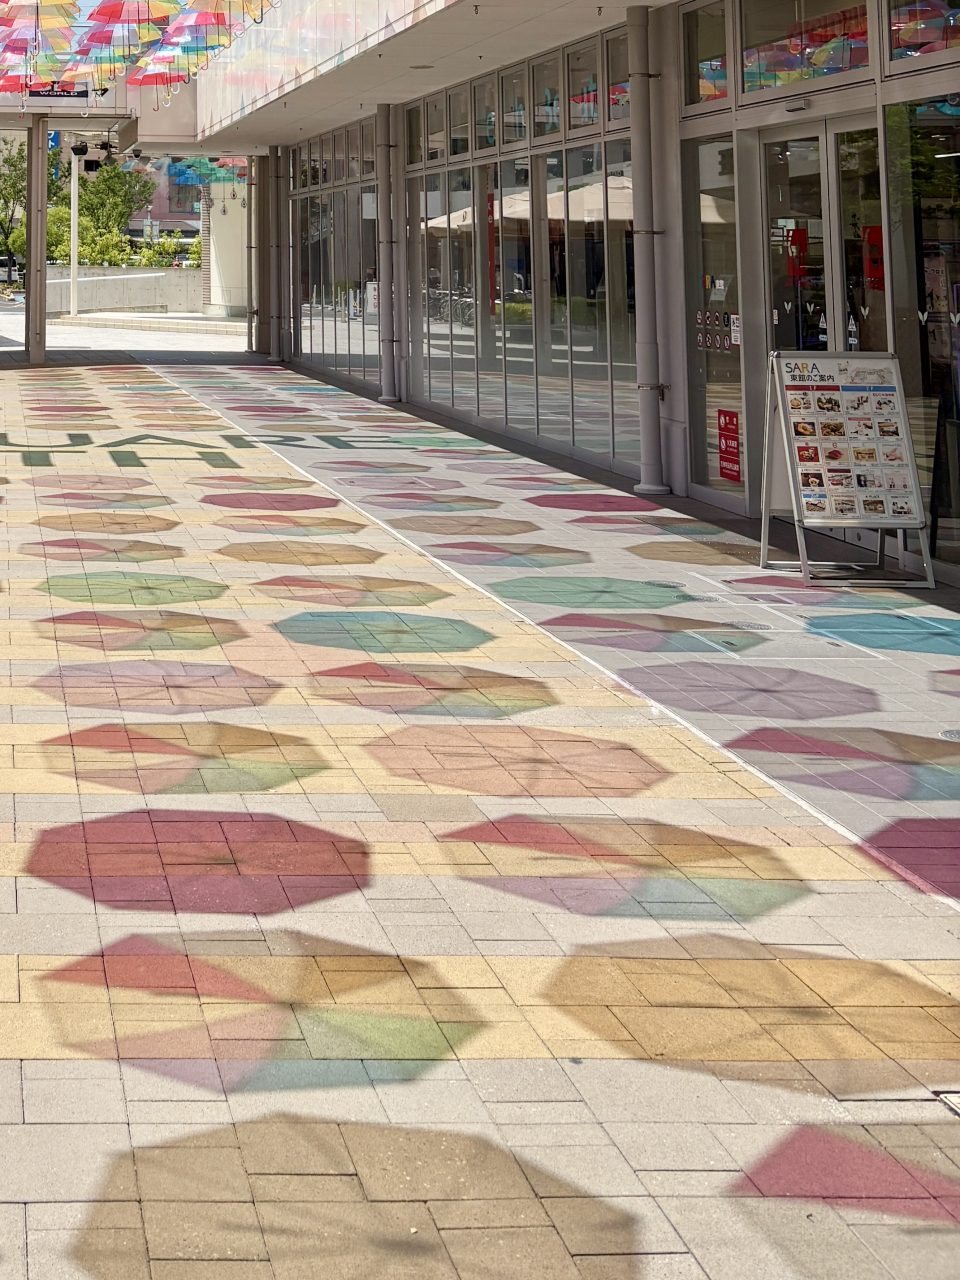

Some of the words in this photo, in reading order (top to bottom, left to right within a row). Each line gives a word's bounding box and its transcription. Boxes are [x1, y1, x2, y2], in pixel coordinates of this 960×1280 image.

[785, 362, 820, 374] SARA
[790, 374, 835, 383] 東館のご案内
